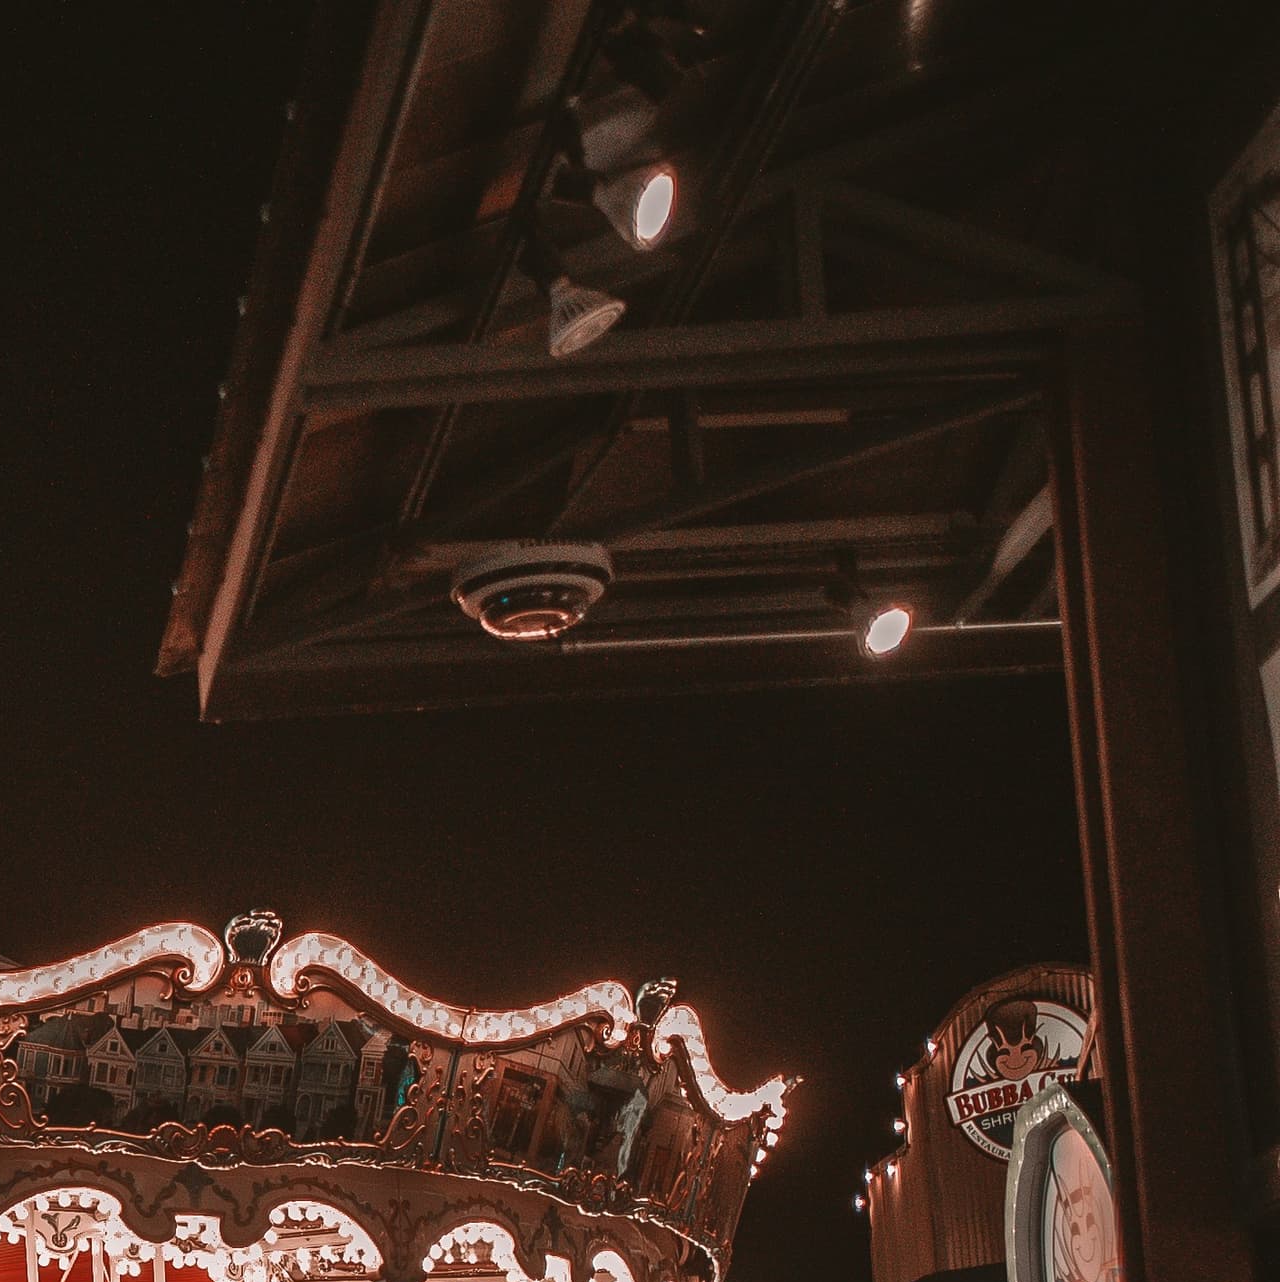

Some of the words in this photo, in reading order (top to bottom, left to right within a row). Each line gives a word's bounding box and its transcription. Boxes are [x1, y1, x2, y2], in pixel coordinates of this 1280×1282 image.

[954, 1079, 1033, 1121] BUBBA
[981, 1112, 1017, 1130] SHRI
[966, 1123, 1011, 1160] RESTAURA
